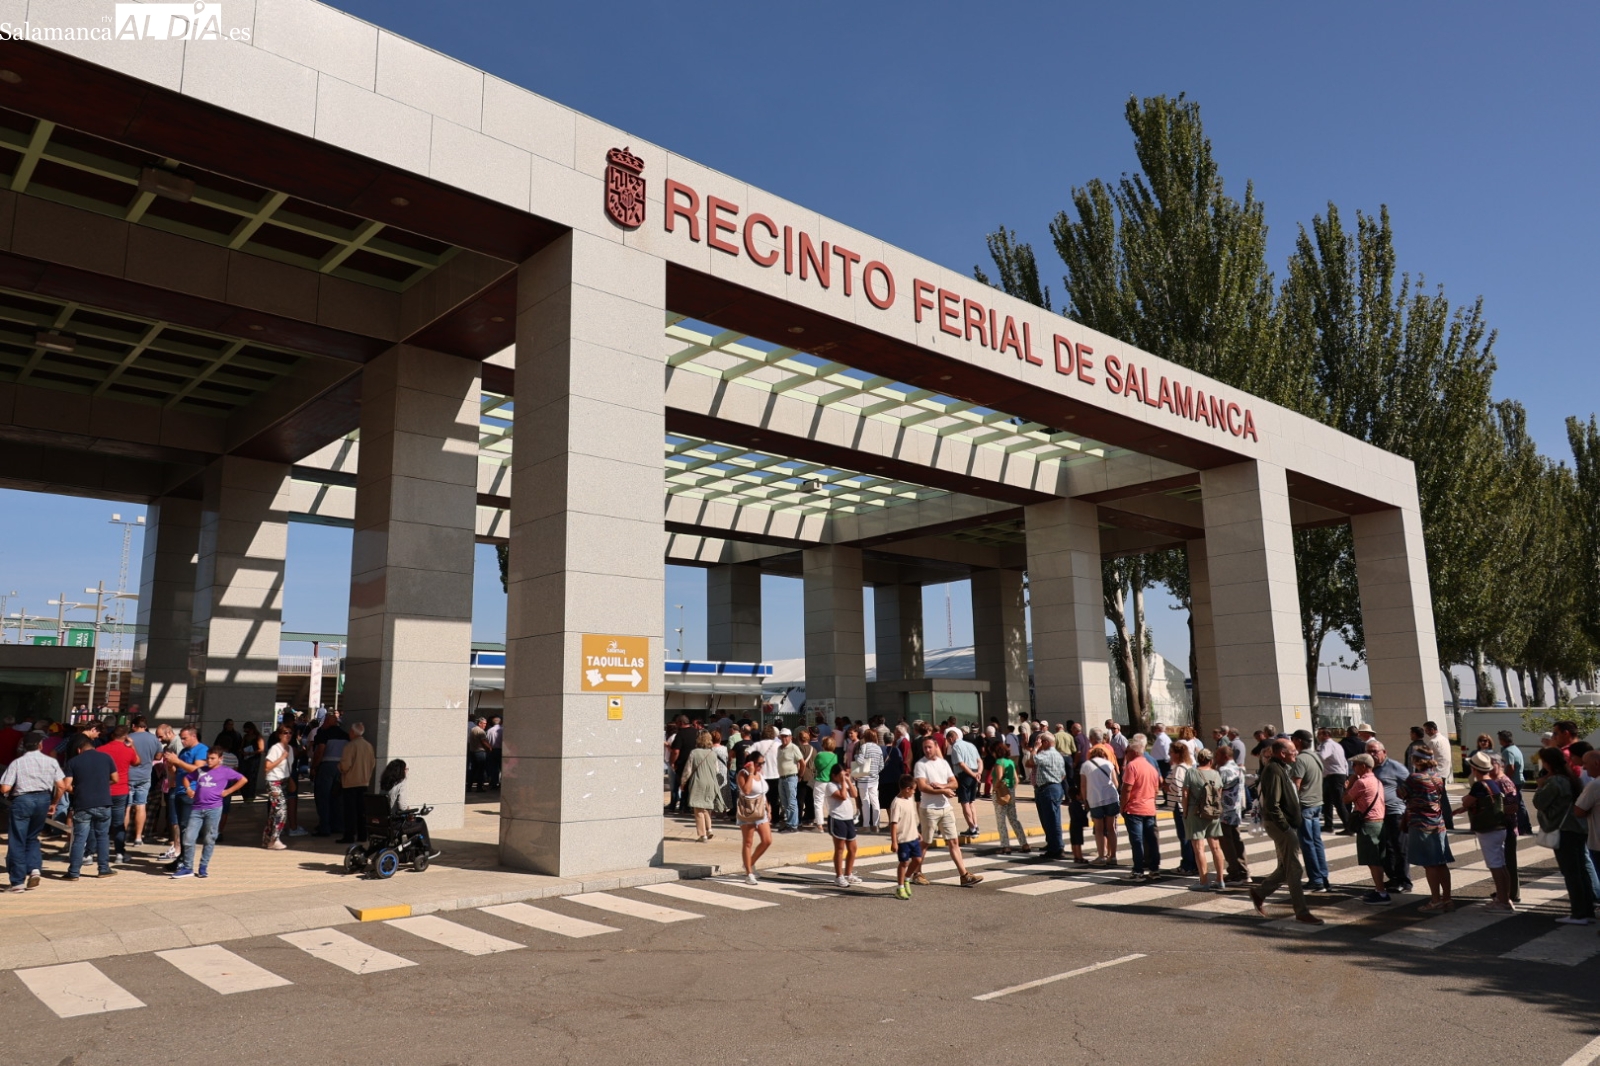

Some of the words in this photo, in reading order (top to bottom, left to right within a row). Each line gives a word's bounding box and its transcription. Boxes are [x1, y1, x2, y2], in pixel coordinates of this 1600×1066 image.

[664, 178, 896, 310] RECINTO
[914, 278, 1043, 366] FERIAL
[1053, 333, 1096, 385] DE
[1105, 354, 1258, 442] SALAMANCA
[586, 656, 644, 668] TAQUILLAS
